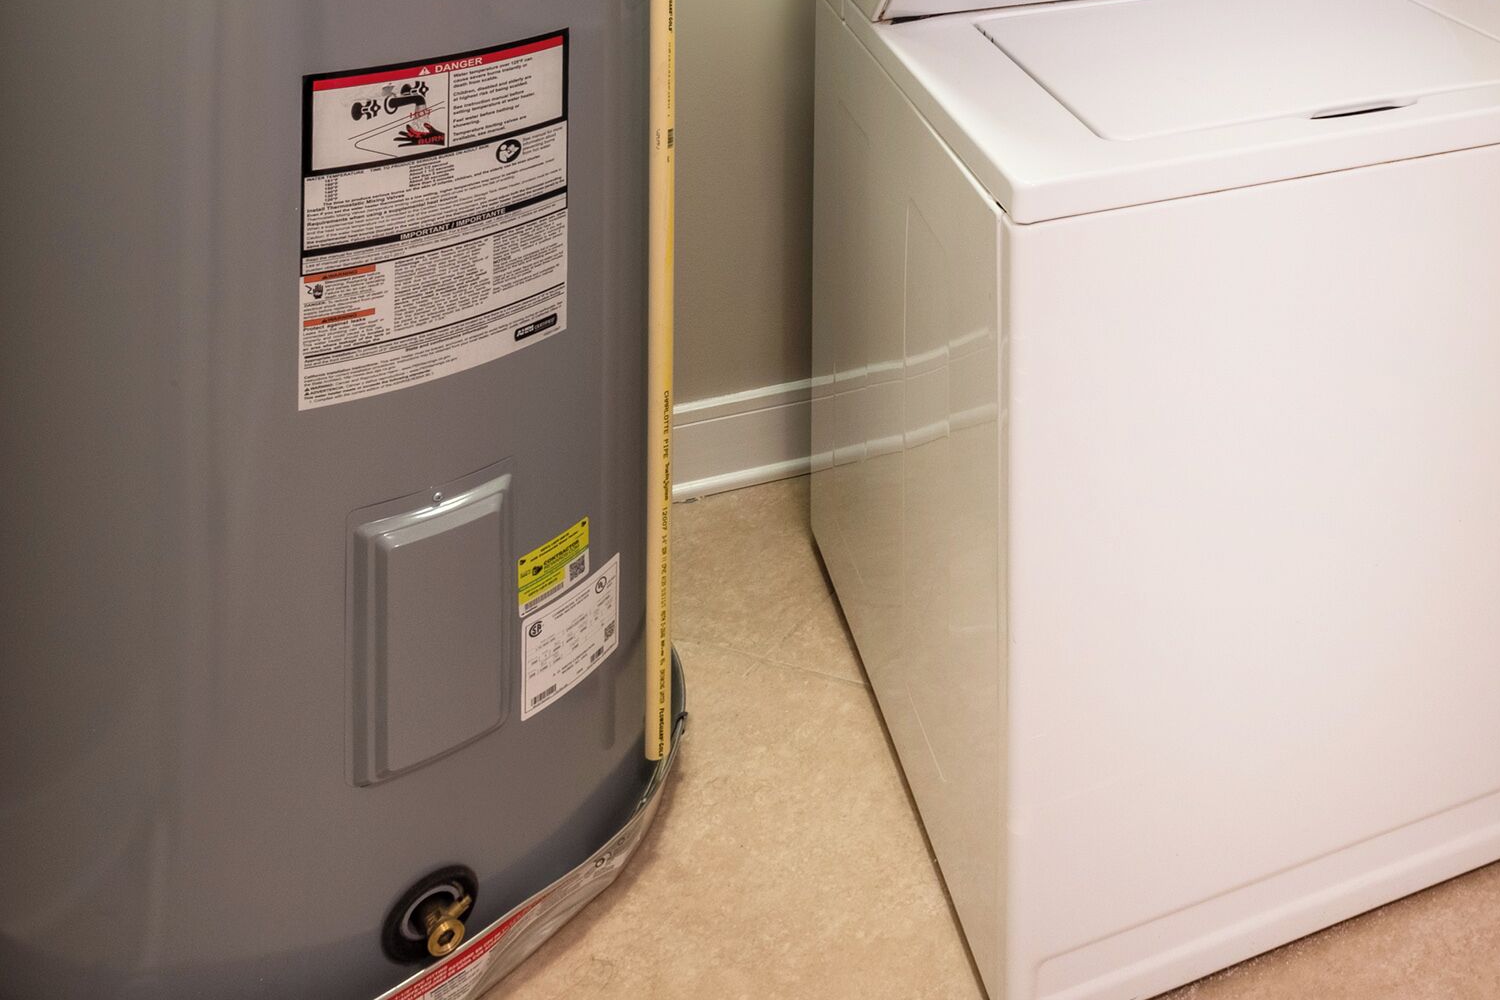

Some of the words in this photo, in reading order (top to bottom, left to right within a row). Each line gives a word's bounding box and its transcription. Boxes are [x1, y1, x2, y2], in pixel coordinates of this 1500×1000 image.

[435, 57, 483, 73] DANGER
[418, 135, 445, 146] BURN
[400, 224, 450, 240] IMPORTANT
[455, 208, 506, 227] IMPORTANTE
